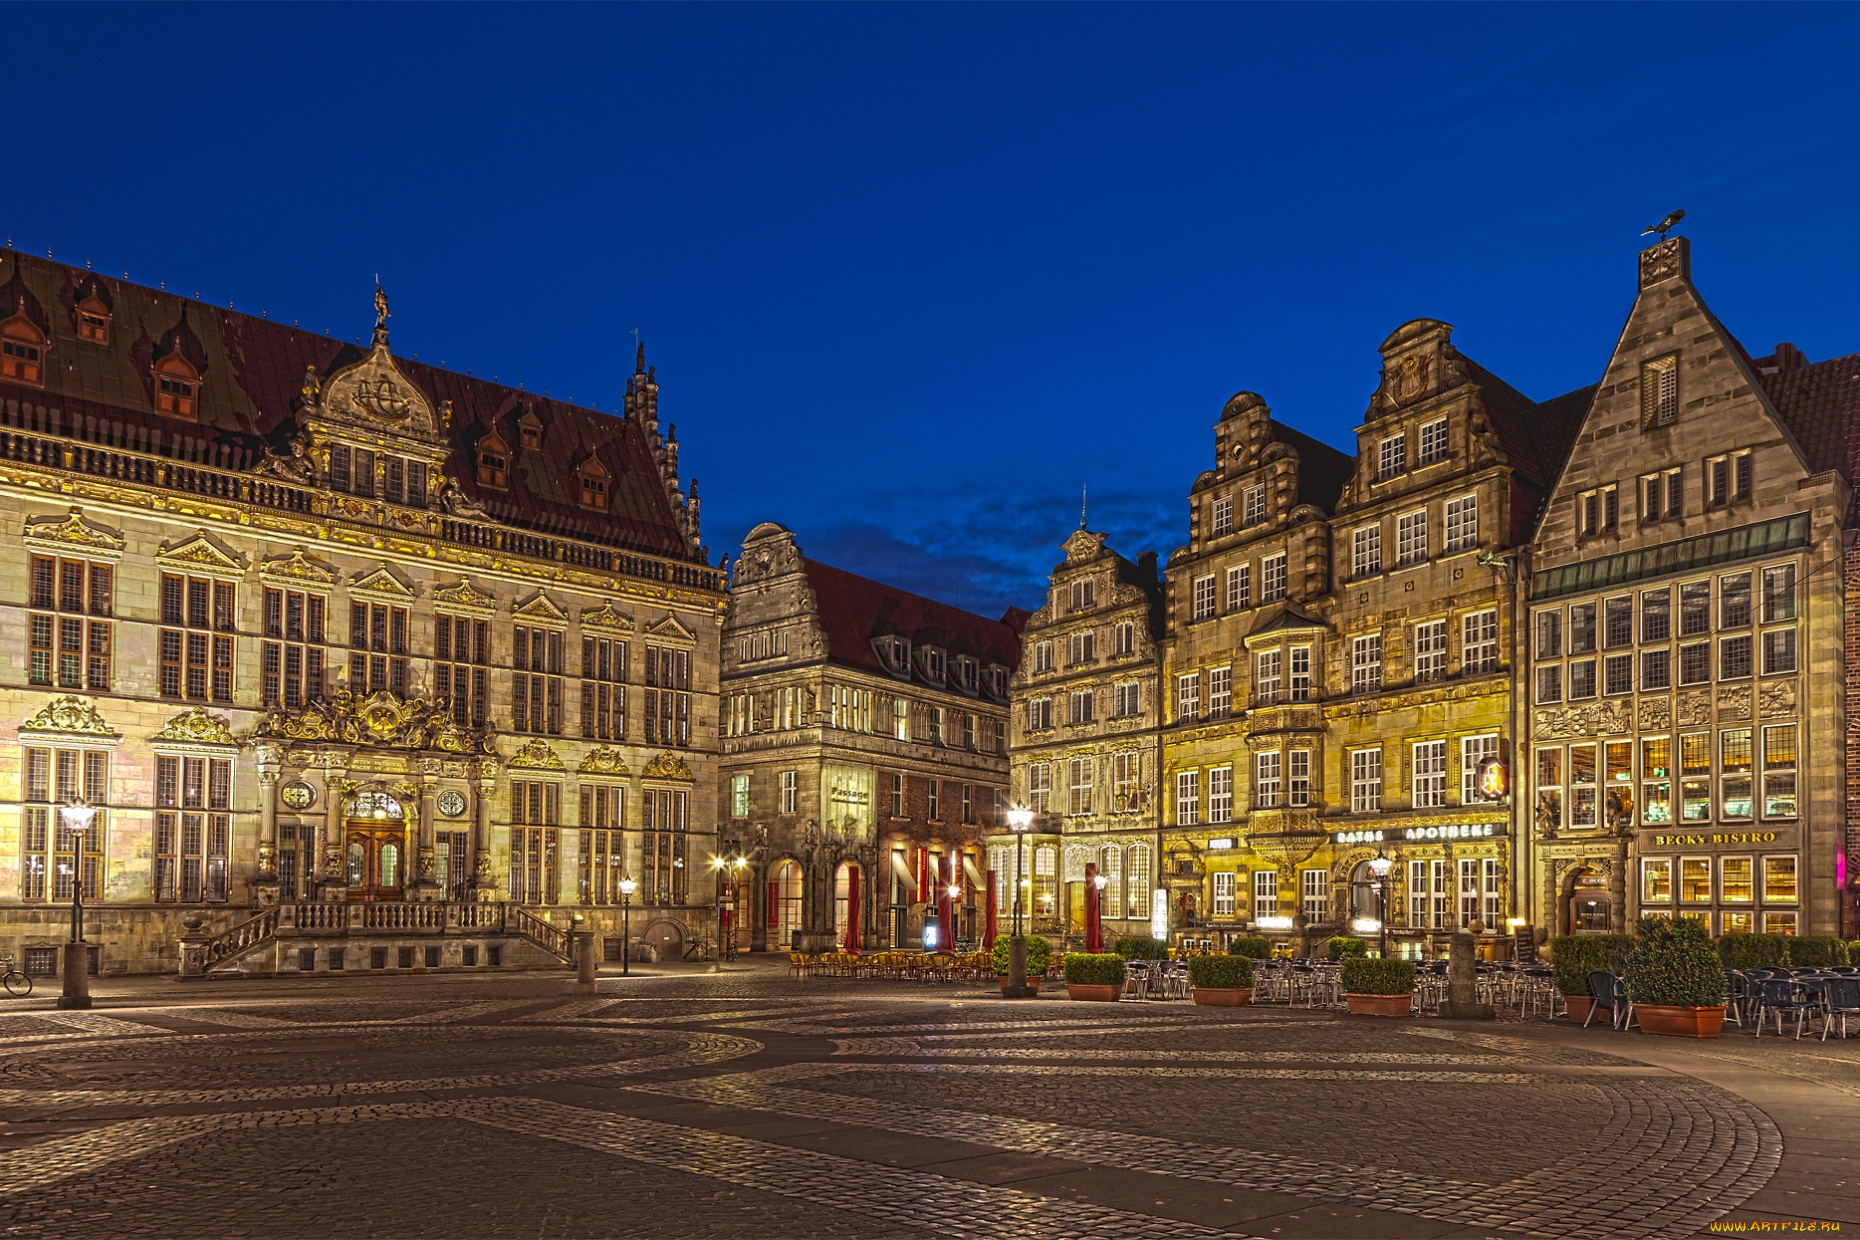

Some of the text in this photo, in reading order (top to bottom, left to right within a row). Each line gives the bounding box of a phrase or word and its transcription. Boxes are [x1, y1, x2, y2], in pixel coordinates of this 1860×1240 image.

[831, 787, 869, 800] Passage
[1337, 824, 1493, 843] RATHS APOTHEKE
[1655, 831, 1775, 846] BECK's BISTRO
